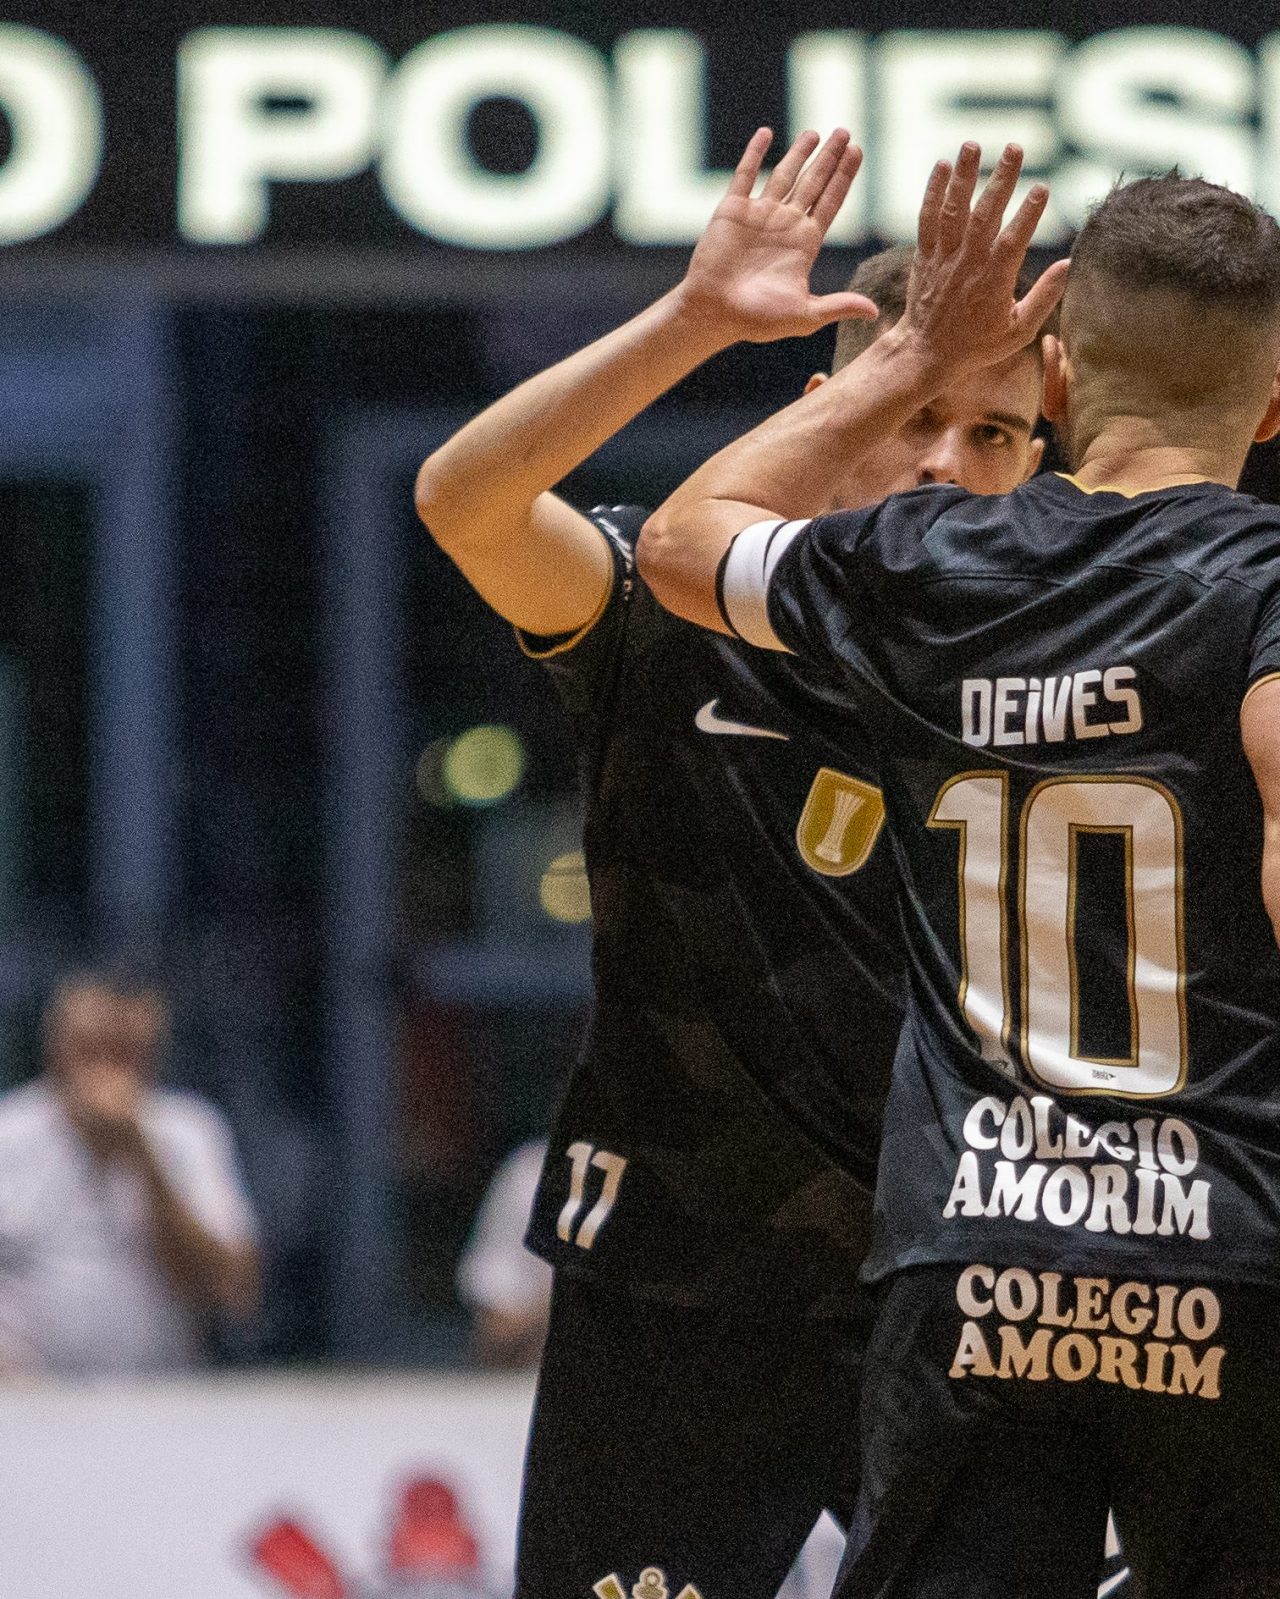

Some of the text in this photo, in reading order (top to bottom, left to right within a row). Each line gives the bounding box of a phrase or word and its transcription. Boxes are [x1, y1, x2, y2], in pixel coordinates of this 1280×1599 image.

[926, 769, 1188, 1100] 10
[962, 1095, 1199, 1177] COLEGIO
[556, 1142, 628, 1250] 17
[942, 1150, 1212, 1240] AMORIM
[955, 1263, 1222, 1341] COLEGIO
[949, 1320, 1226, 1399] AMORIM
